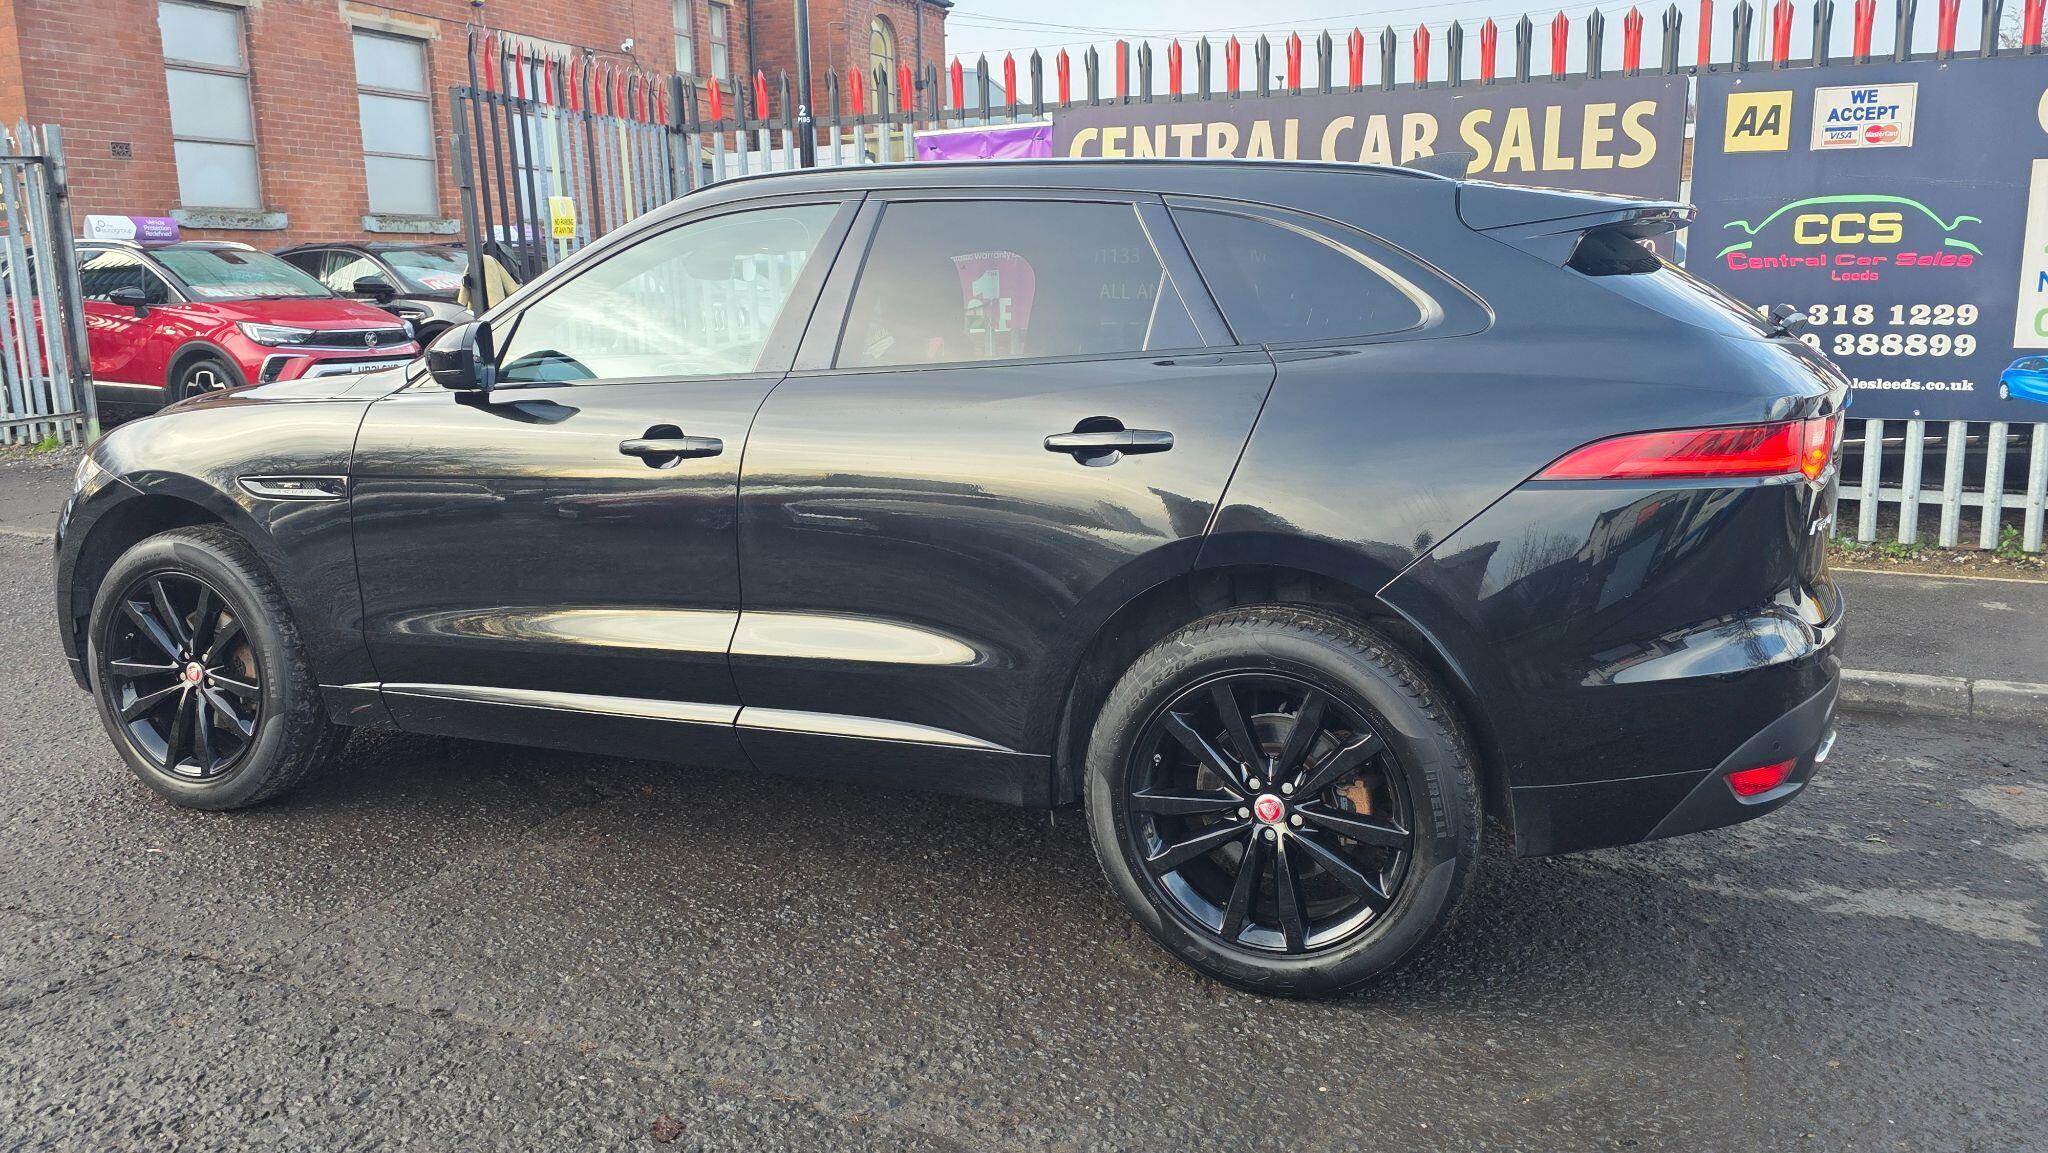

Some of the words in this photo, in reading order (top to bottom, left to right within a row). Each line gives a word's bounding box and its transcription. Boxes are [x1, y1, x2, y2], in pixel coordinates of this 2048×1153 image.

[1851, 89, 1879, 104] WE
[798, 104, 806, 117] 2
[1827, 105, 1900, 122] ACCEPT
[1732, 105, 1782, 137] AA
[1320, 112, 1439, 167] CAR
[1459, 100, 1657, 174] SALES
[1830, 131, 1852, 140] VISA
[1794, 212, 1903, 245] CCS
[1727, 252, 1827, 270] Central
[1835, 253, 1888, 266] Car
[1895, 251, 1974, 267] Sales
[1831, 270, 1879, 281] Leeds
[1807, 304, 1875, 326] 318
[1889, 303, 1979, 326] 1229
[1833, 333, 1978, 357] 388899
[1850, 377, 1974, 391] lesleeds.co.uk
